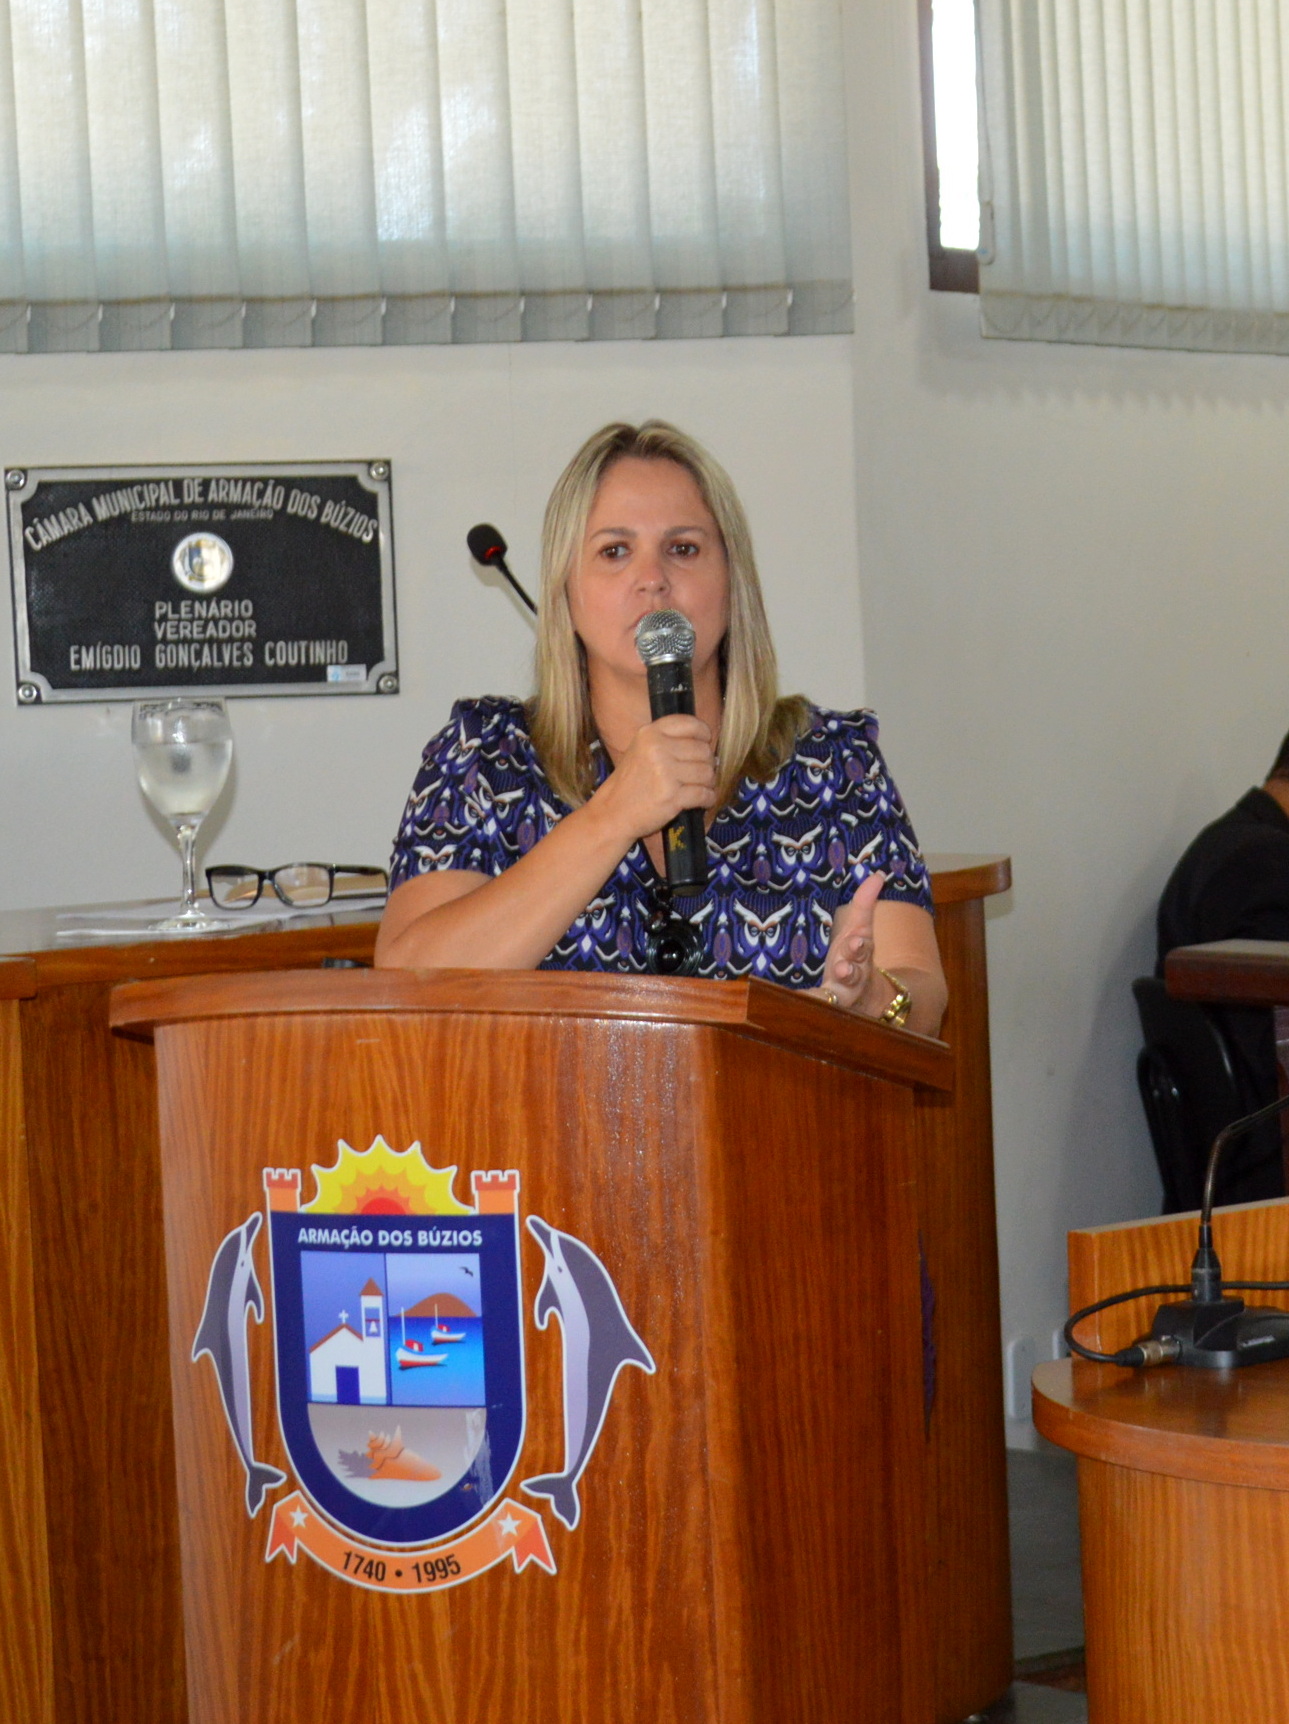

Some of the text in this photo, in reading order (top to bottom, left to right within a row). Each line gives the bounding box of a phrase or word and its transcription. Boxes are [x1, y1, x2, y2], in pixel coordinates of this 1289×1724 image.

[91, 479, 181, 522] MUNICIPAL
[183, 478, 204, 504] DE
[207, 478, 286, 511] ARMAÇÃO
[286, 488, 321, 520] DOS
[319, 499, 378, 543] BÚZIOS
[131, 507, 274, 523] ESTADO DO RIO DE JANEIRO
[155, 596, 254, 619] PLENÁRIO
[154, 619, 257, 640] VEREADOR
[70, 640, 349, 673] EMÍGDIO GONÇALVES COUTINHO
[297, 1225, 483, 1250] ARMAÇÃO DOS BÚZIOS
[343, 1550, 461, 1583] 1740 1995
